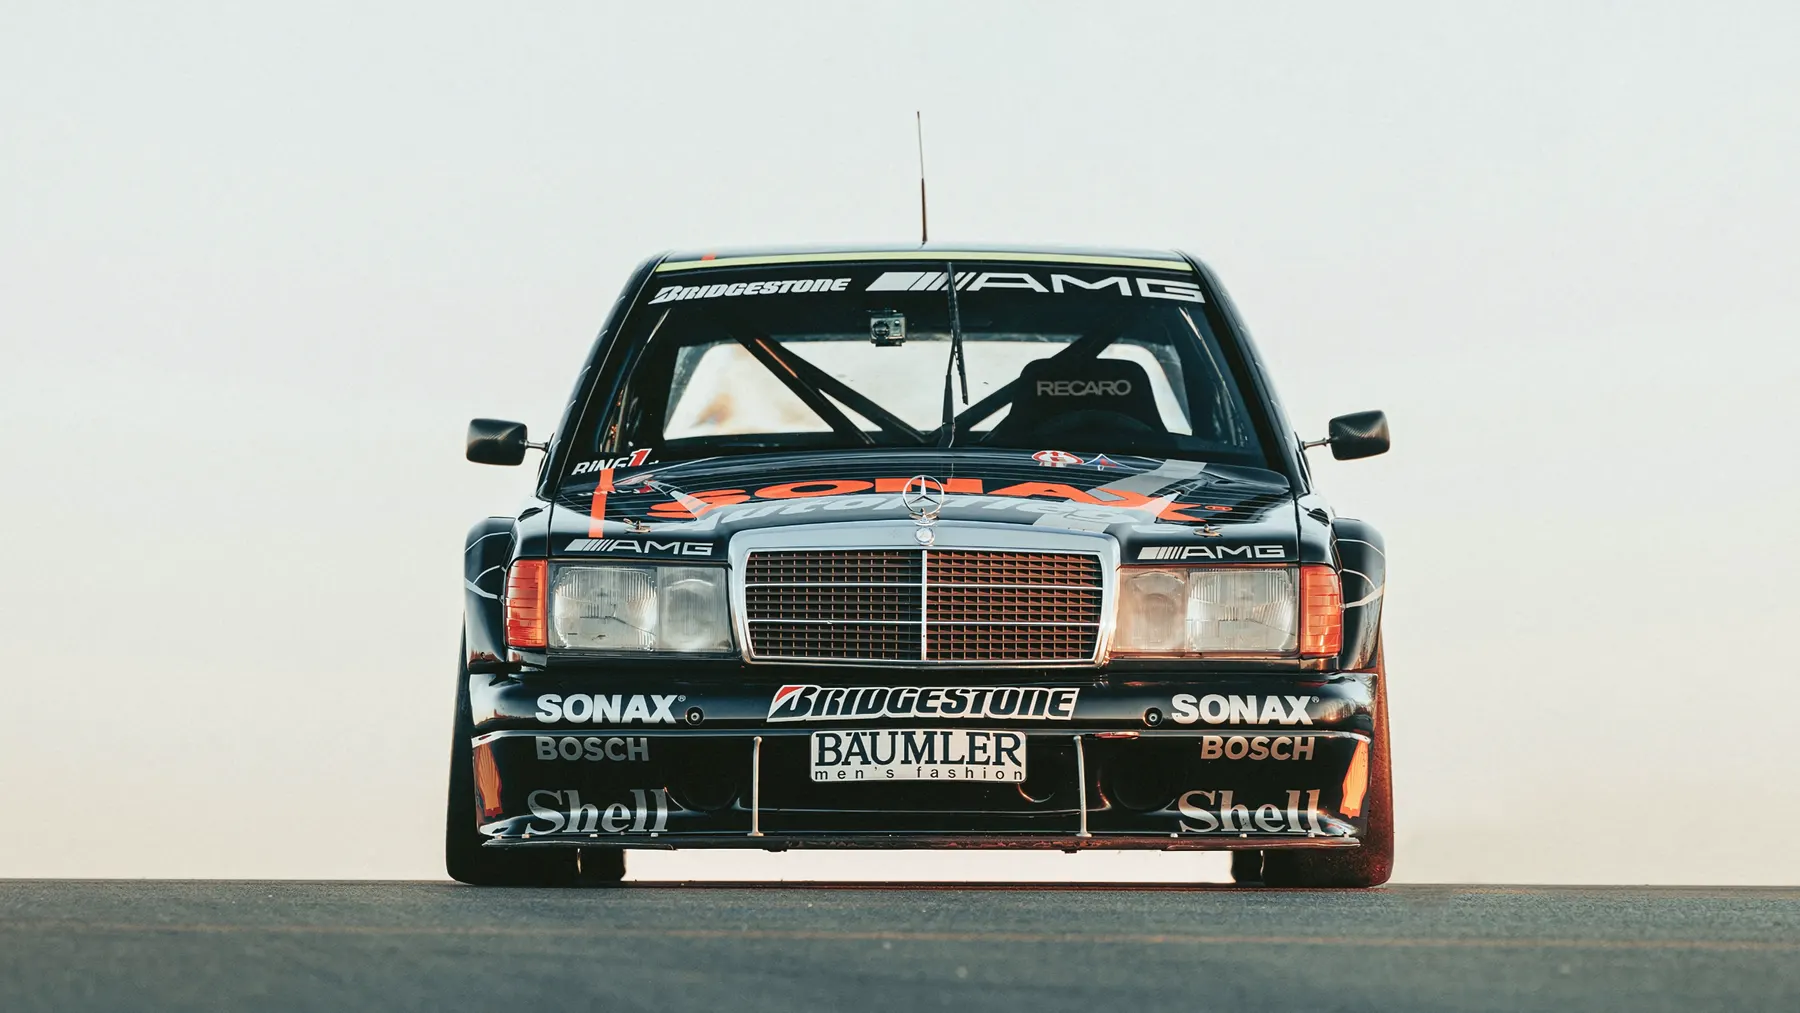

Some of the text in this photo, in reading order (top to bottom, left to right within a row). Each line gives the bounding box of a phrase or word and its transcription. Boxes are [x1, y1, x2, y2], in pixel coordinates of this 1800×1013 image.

[648, 278, 852, 305] BRIDGESTONE
[965, 271, 1206, 304] AMG
[1036, 379, 1132, 397] RECARO
[606, 539, 714, 556] AMG
[1180, 544, 1286, 560] AMG
[766, 684, 1081, 723] BRIDGESTONE
[535, 735, 650, 762] BOSCH
[1200, 735, 1316, 761] BOSCH
[815, 766, 1023, 780] men's fashion
[524, 788, 669, 836] Shell
[1177, 788, 1326, 837] Shell
